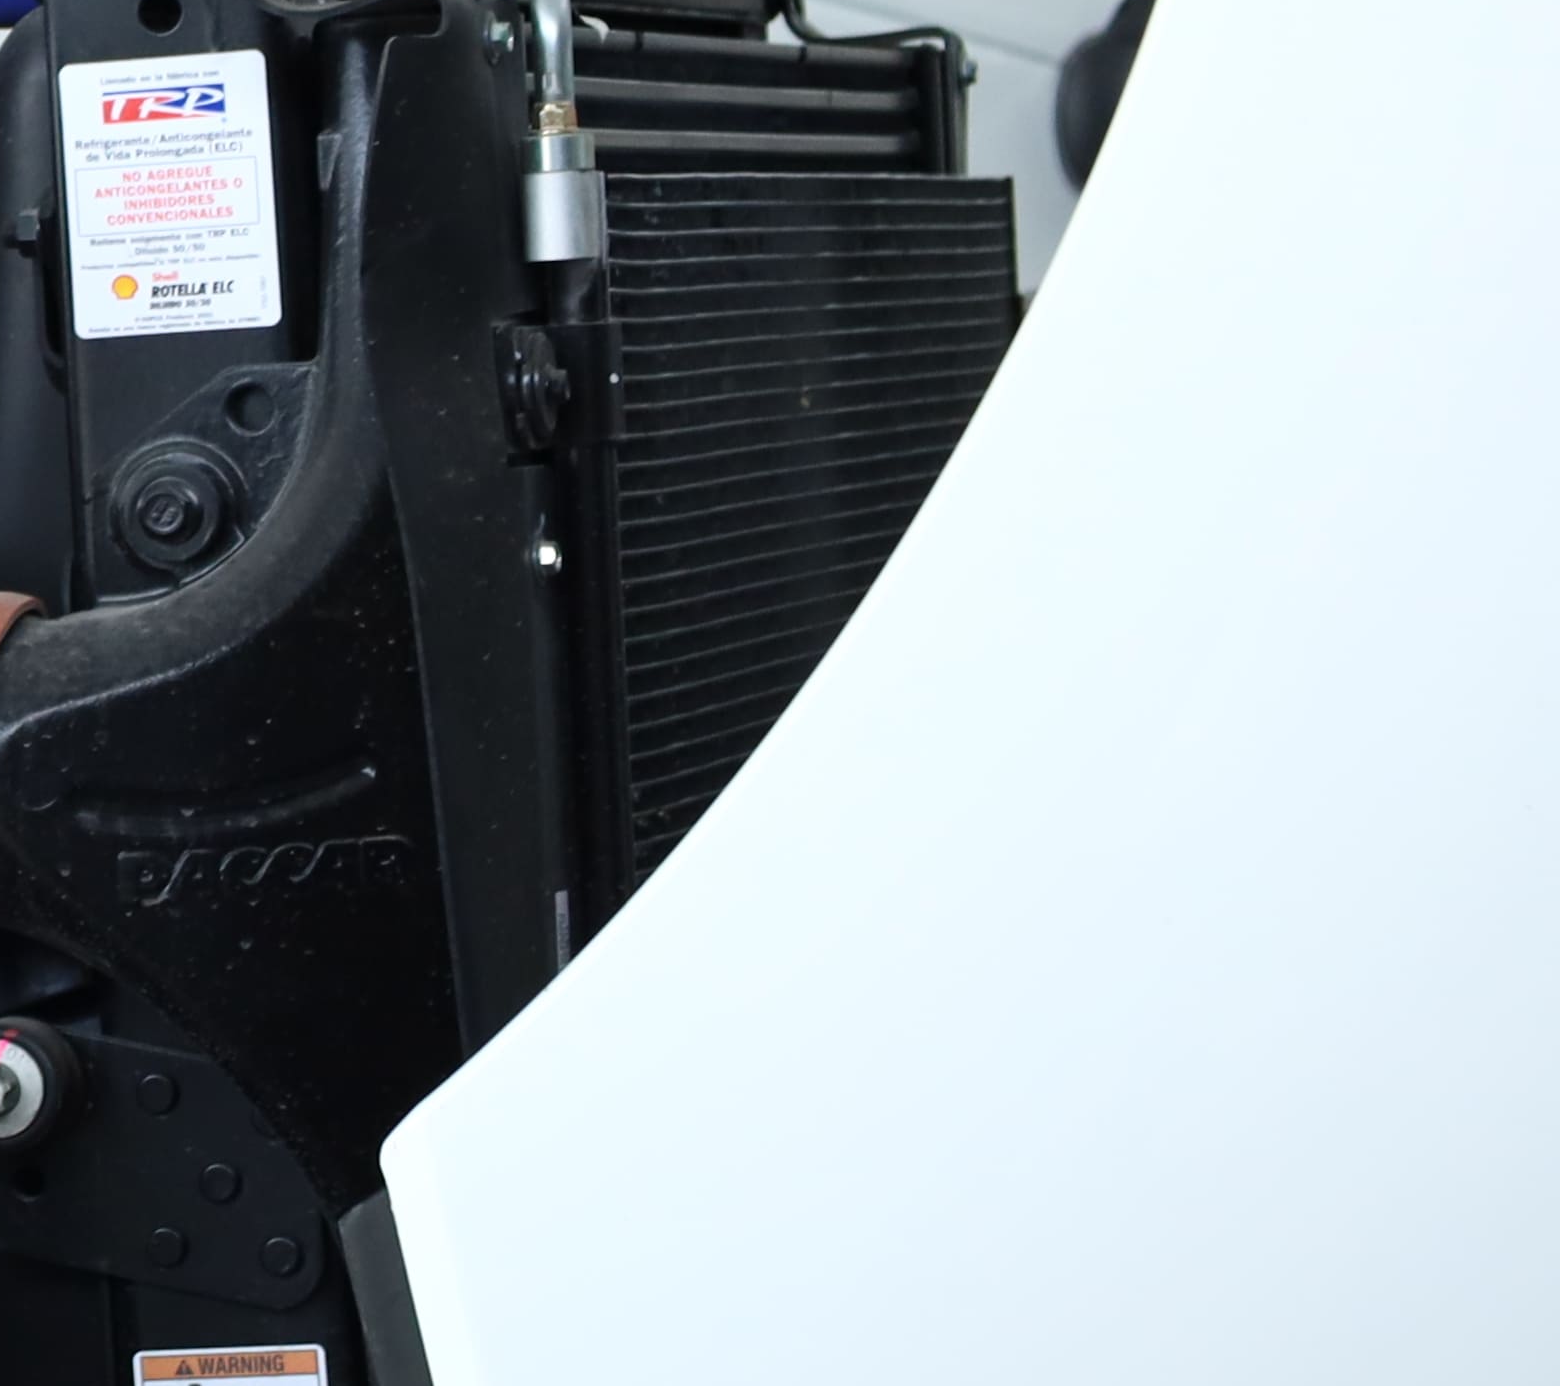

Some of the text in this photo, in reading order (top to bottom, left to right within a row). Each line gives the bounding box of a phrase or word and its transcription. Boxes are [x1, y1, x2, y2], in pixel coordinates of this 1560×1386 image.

[103, 85, 225, 123] TRP
[86, 152, 99, 162] de
[106, 149, 131, 161] Vida
[122, 166, 213, 182] NO AGREGUE
[95, 178, 228, 198] ANTICONGELANTES
[124, 194, 215, 210] INHIBIDORES
[107, 206, 233, 226] CONVENCIONALES
[151, 280, 235, 298] ROTELLA ELC
[198, 1355, 285, 1375] WARNING
